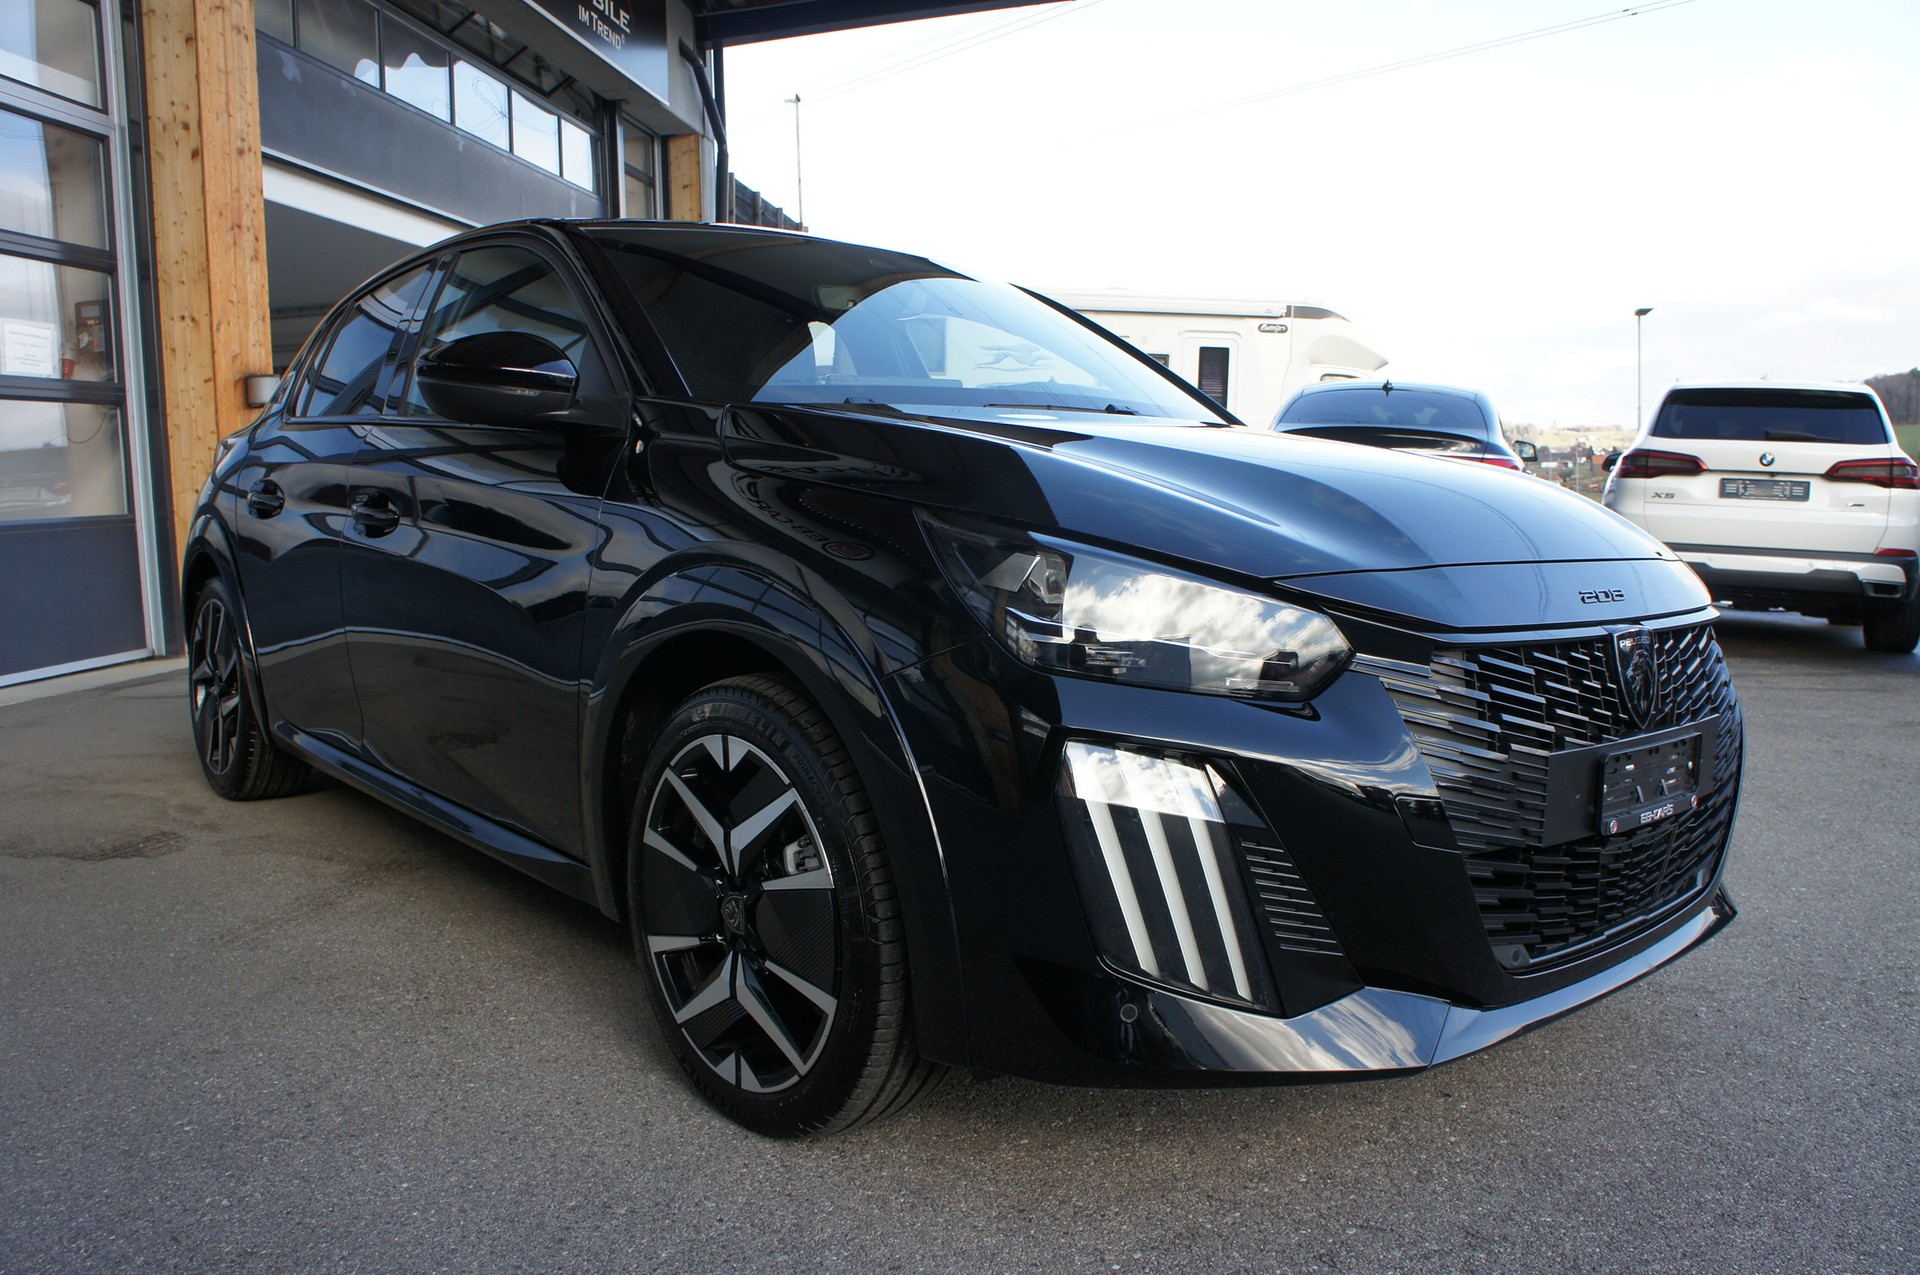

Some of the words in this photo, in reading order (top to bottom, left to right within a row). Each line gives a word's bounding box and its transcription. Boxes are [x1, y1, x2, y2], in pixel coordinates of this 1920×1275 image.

[578, 5, 589, 26] IM
[1651, 491, 1675, 499] X5
[1579, 589, 1626, 605] 208
